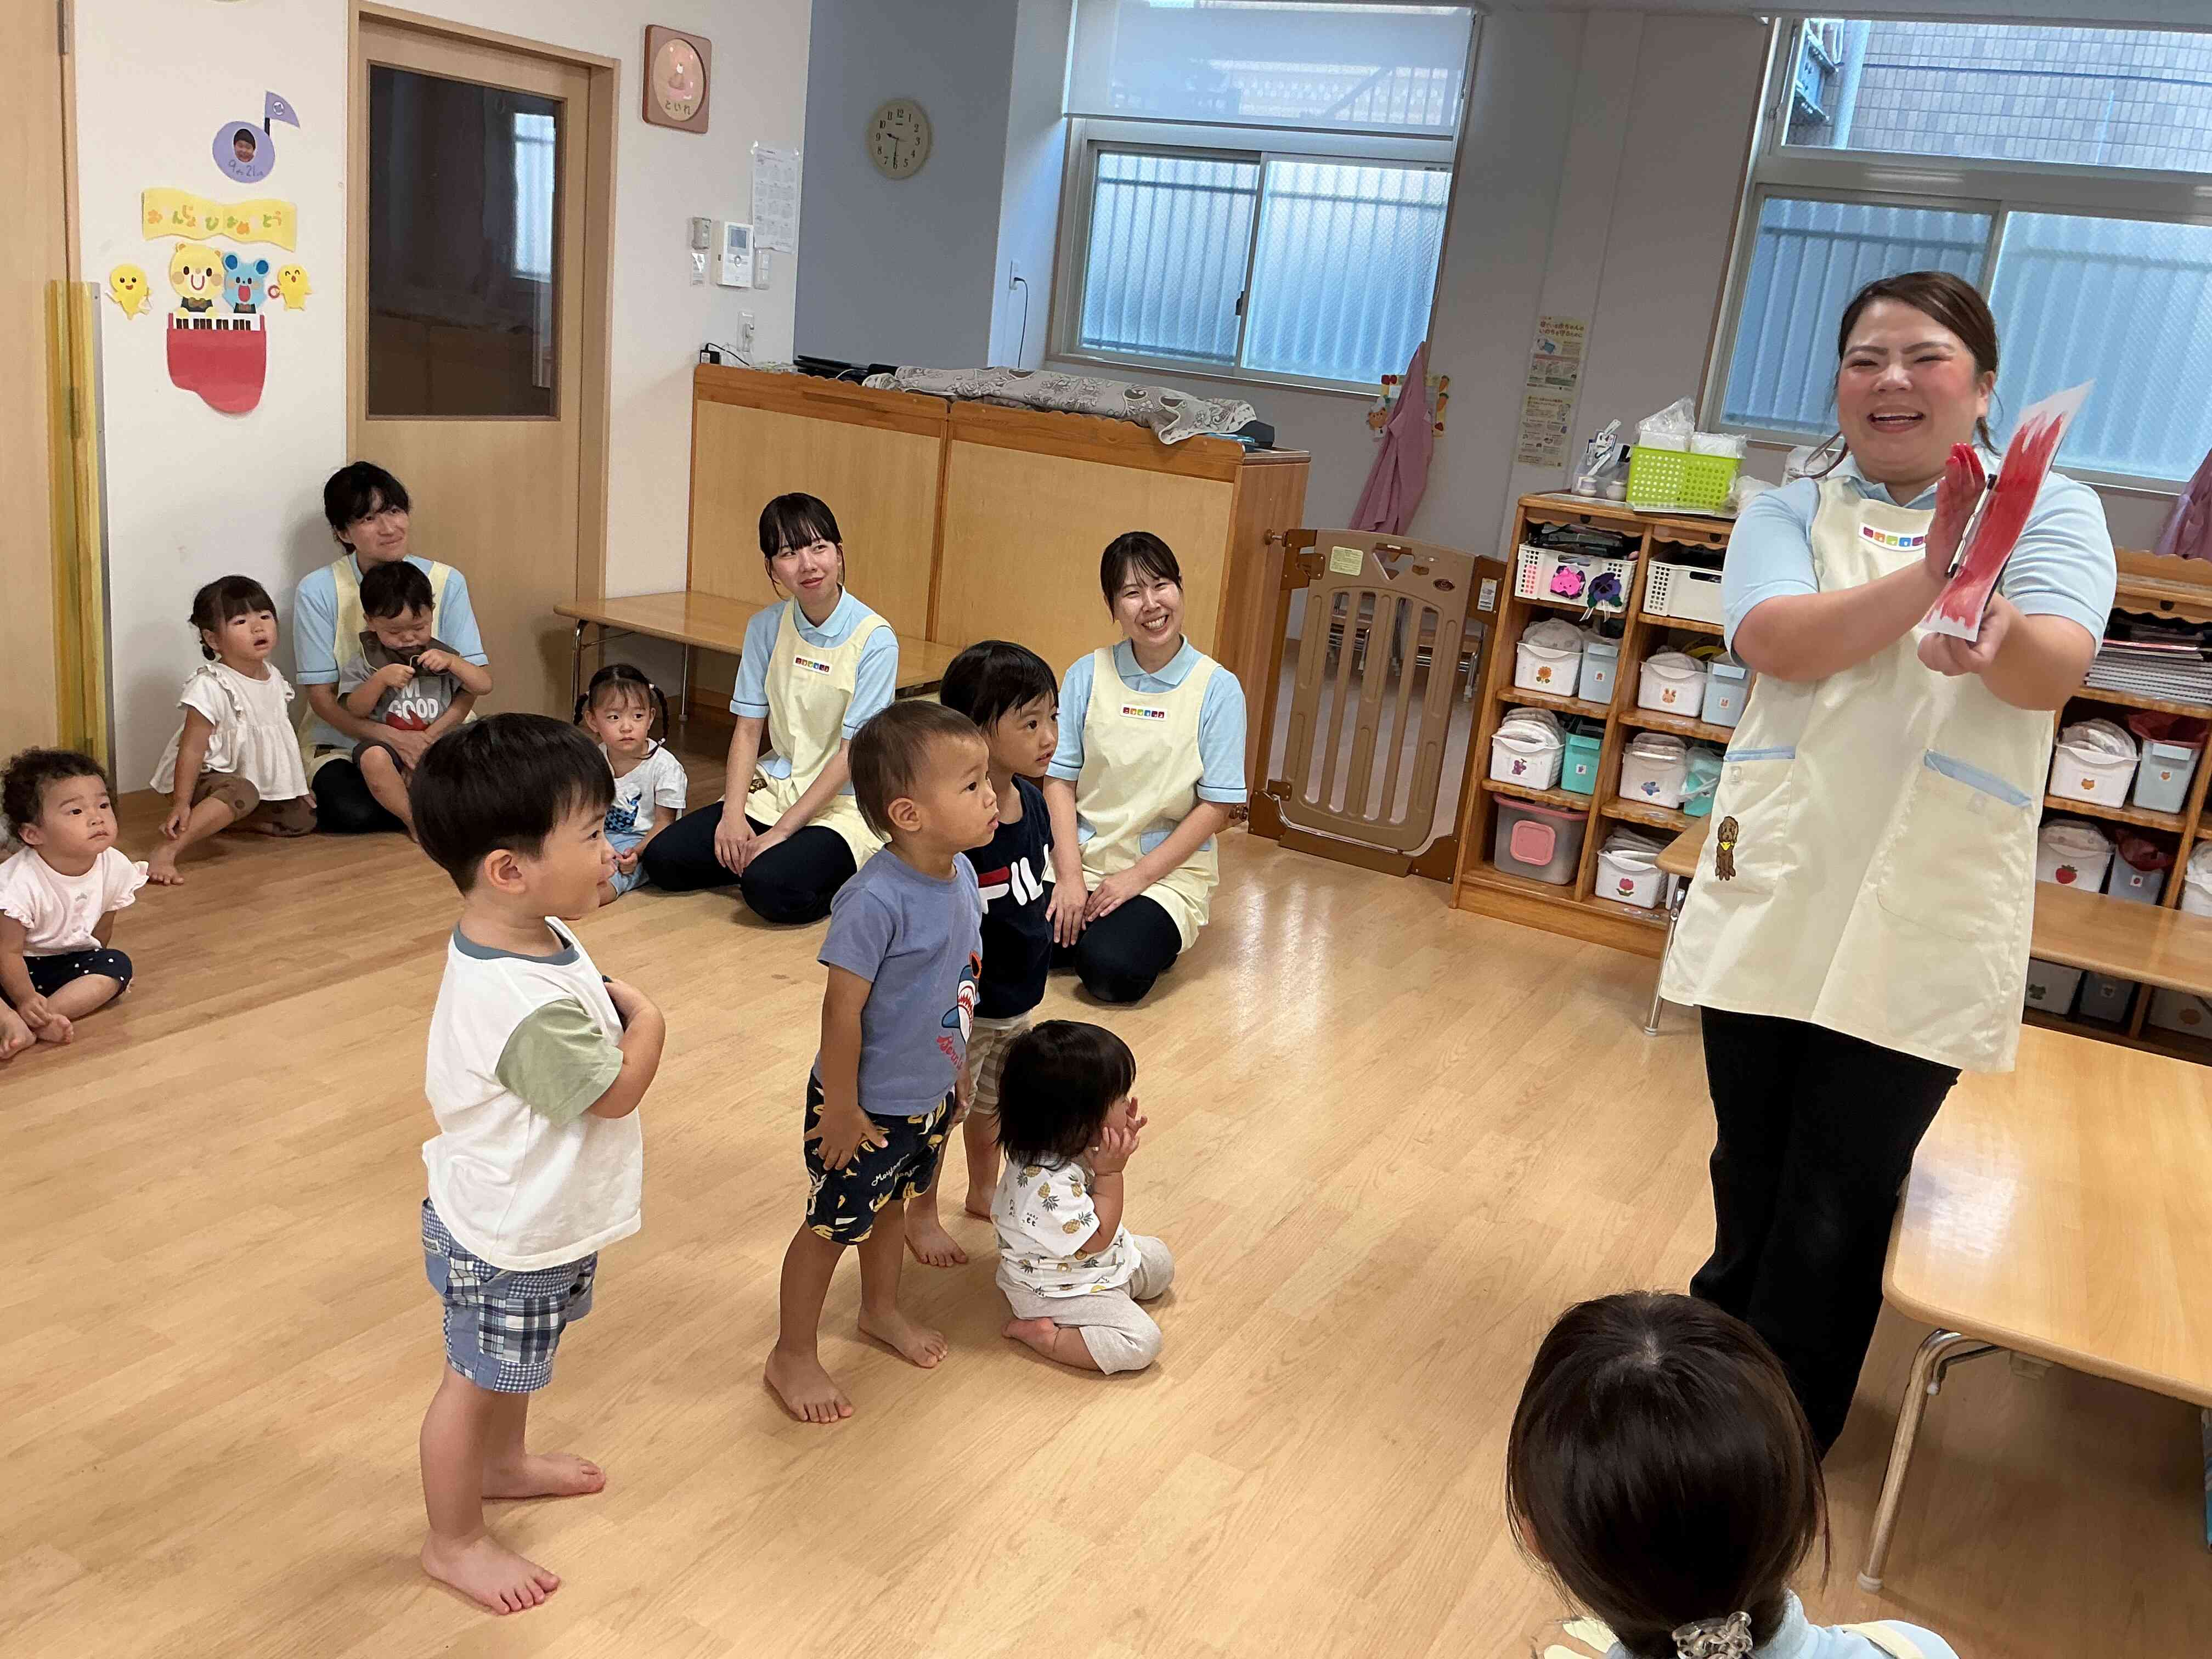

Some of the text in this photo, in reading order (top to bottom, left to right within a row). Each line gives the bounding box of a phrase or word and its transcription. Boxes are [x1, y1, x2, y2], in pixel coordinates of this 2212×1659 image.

[665, 100, 690, 115] といれ
[887, 111, 893, 120] 11
[897, 109, 904, 118] 12
[909, 114, 912, 122] 1
[879, 120, 886, 128] 10
[914, 123, 919, 132] 2
[876, 132, 881, 141] 9
[915, 137, 920, 146] 3
[878, 146, 882, 154] 8
[883, 156, 888, 165] 7
[904, 159, 908, 167] 5
[388, 698, 438, 720] GOOD
